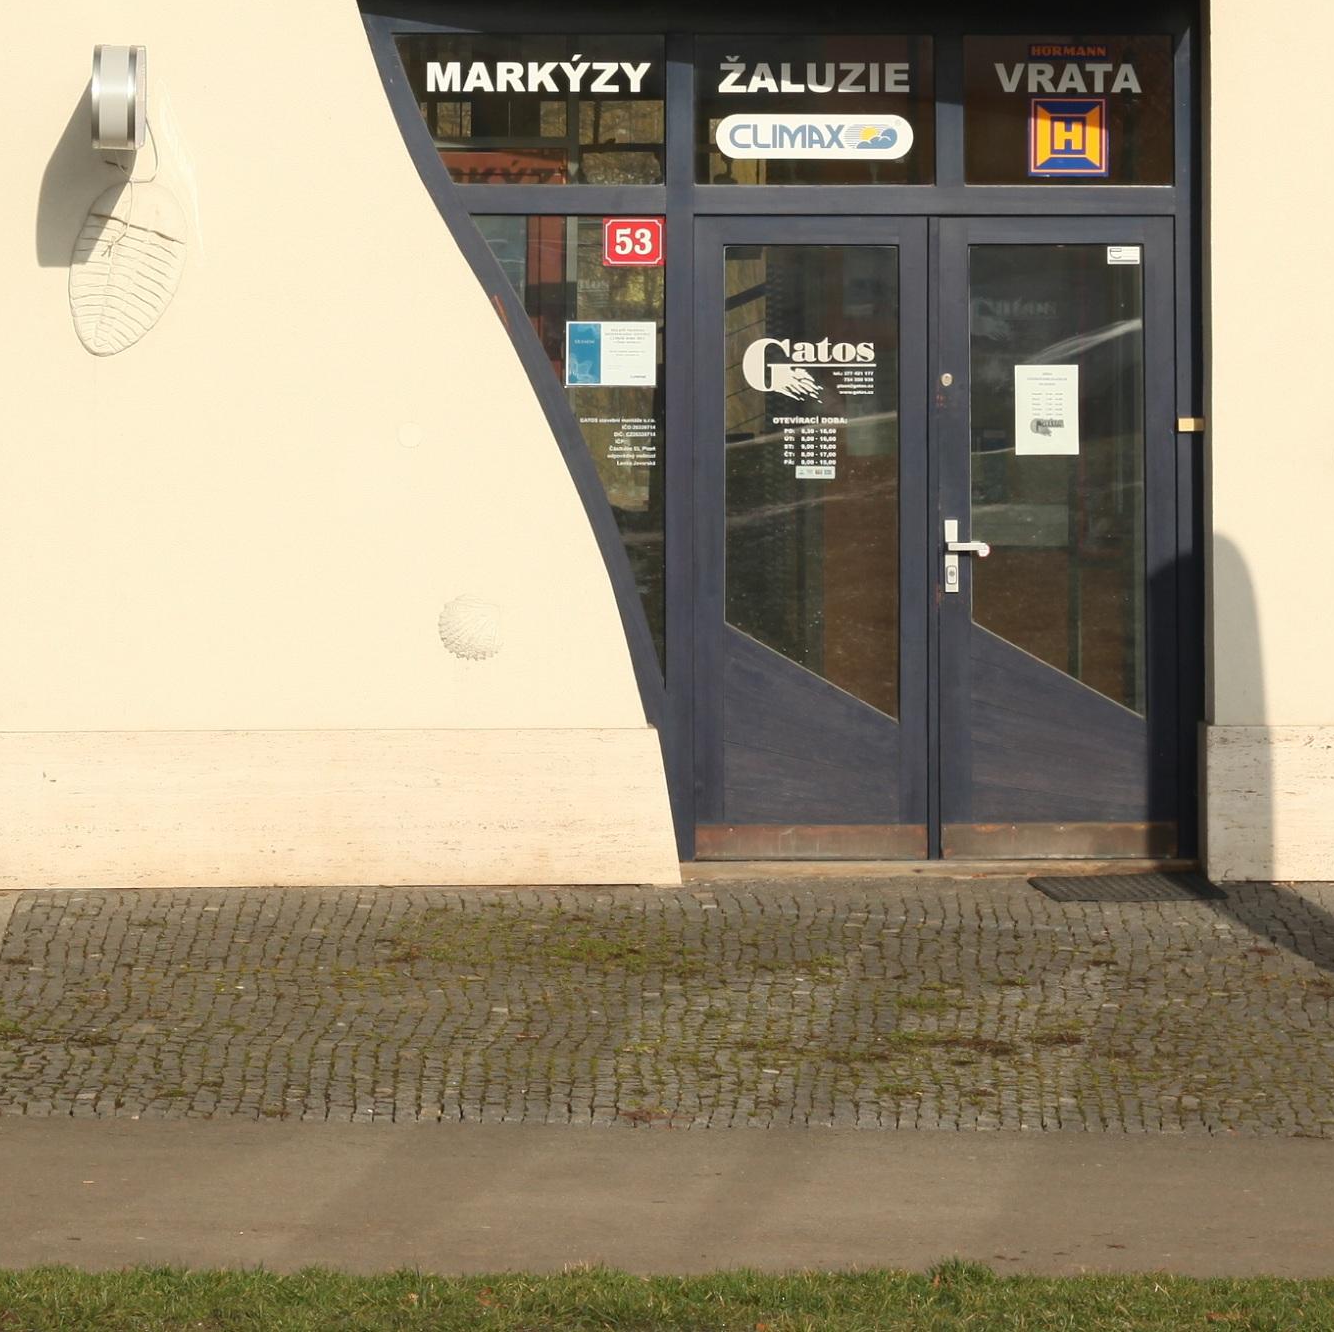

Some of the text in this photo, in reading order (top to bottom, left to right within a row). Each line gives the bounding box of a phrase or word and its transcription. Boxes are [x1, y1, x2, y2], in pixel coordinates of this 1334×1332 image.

[426, 54, 652, 93] MARKÝZY
[718, 55, 911, 93] ŽALUZIE
[994, 63, 1143, 93] VRATA
[729, 124, 846, 149] CLIMAX
[614, 228, 653, 255] 53
[742, 336, 876, 392] Gatos
[772, 416, 819, 424] OTEVÍRACÍ
